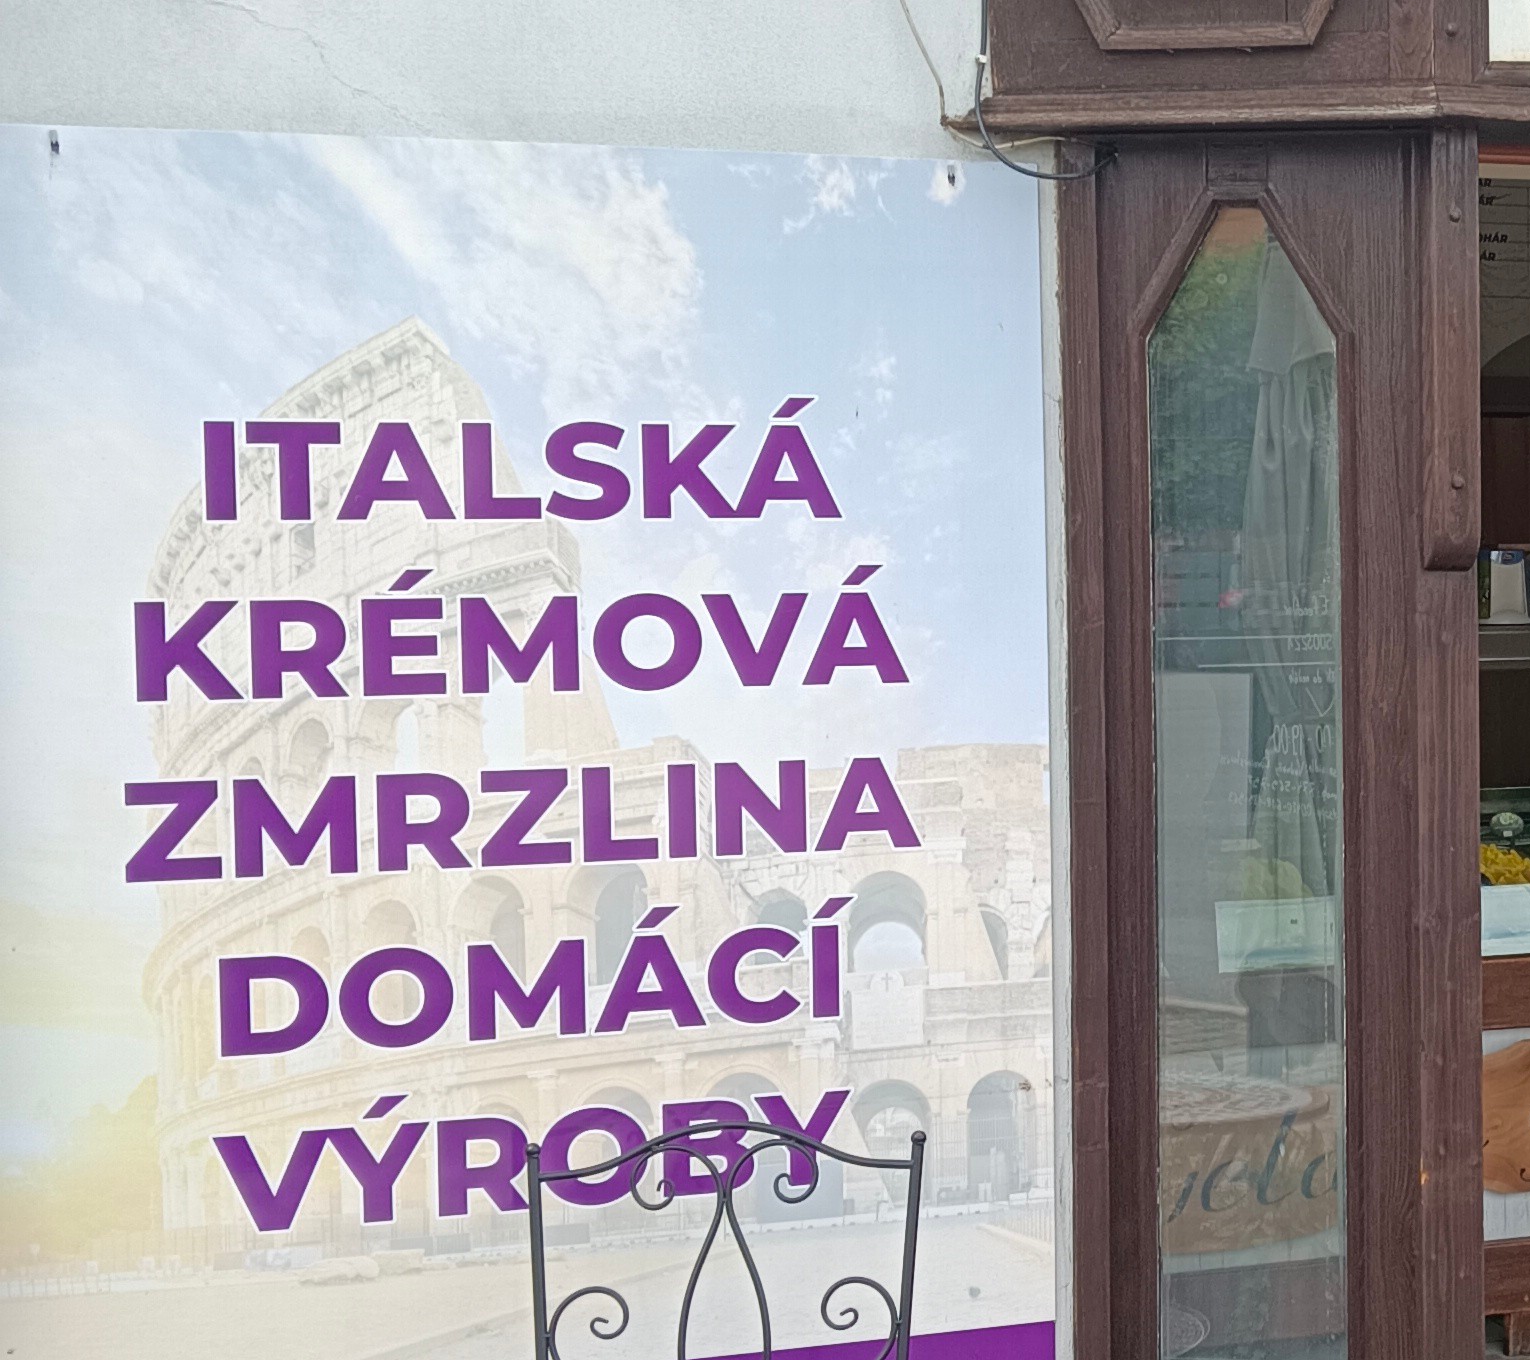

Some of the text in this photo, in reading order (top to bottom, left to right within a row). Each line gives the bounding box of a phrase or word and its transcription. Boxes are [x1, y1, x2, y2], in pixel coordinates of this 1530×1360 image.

[204, 398, 840, 521] ITALSKÁ
[134, 566, 908, 701] KRÉMOVÁ
[126, 757, 919, 882] ZMRZLINA
[218, 897, 853, 1056] DOMÁCÍ
[214, 1090, 851, 1231] VÝROBY
